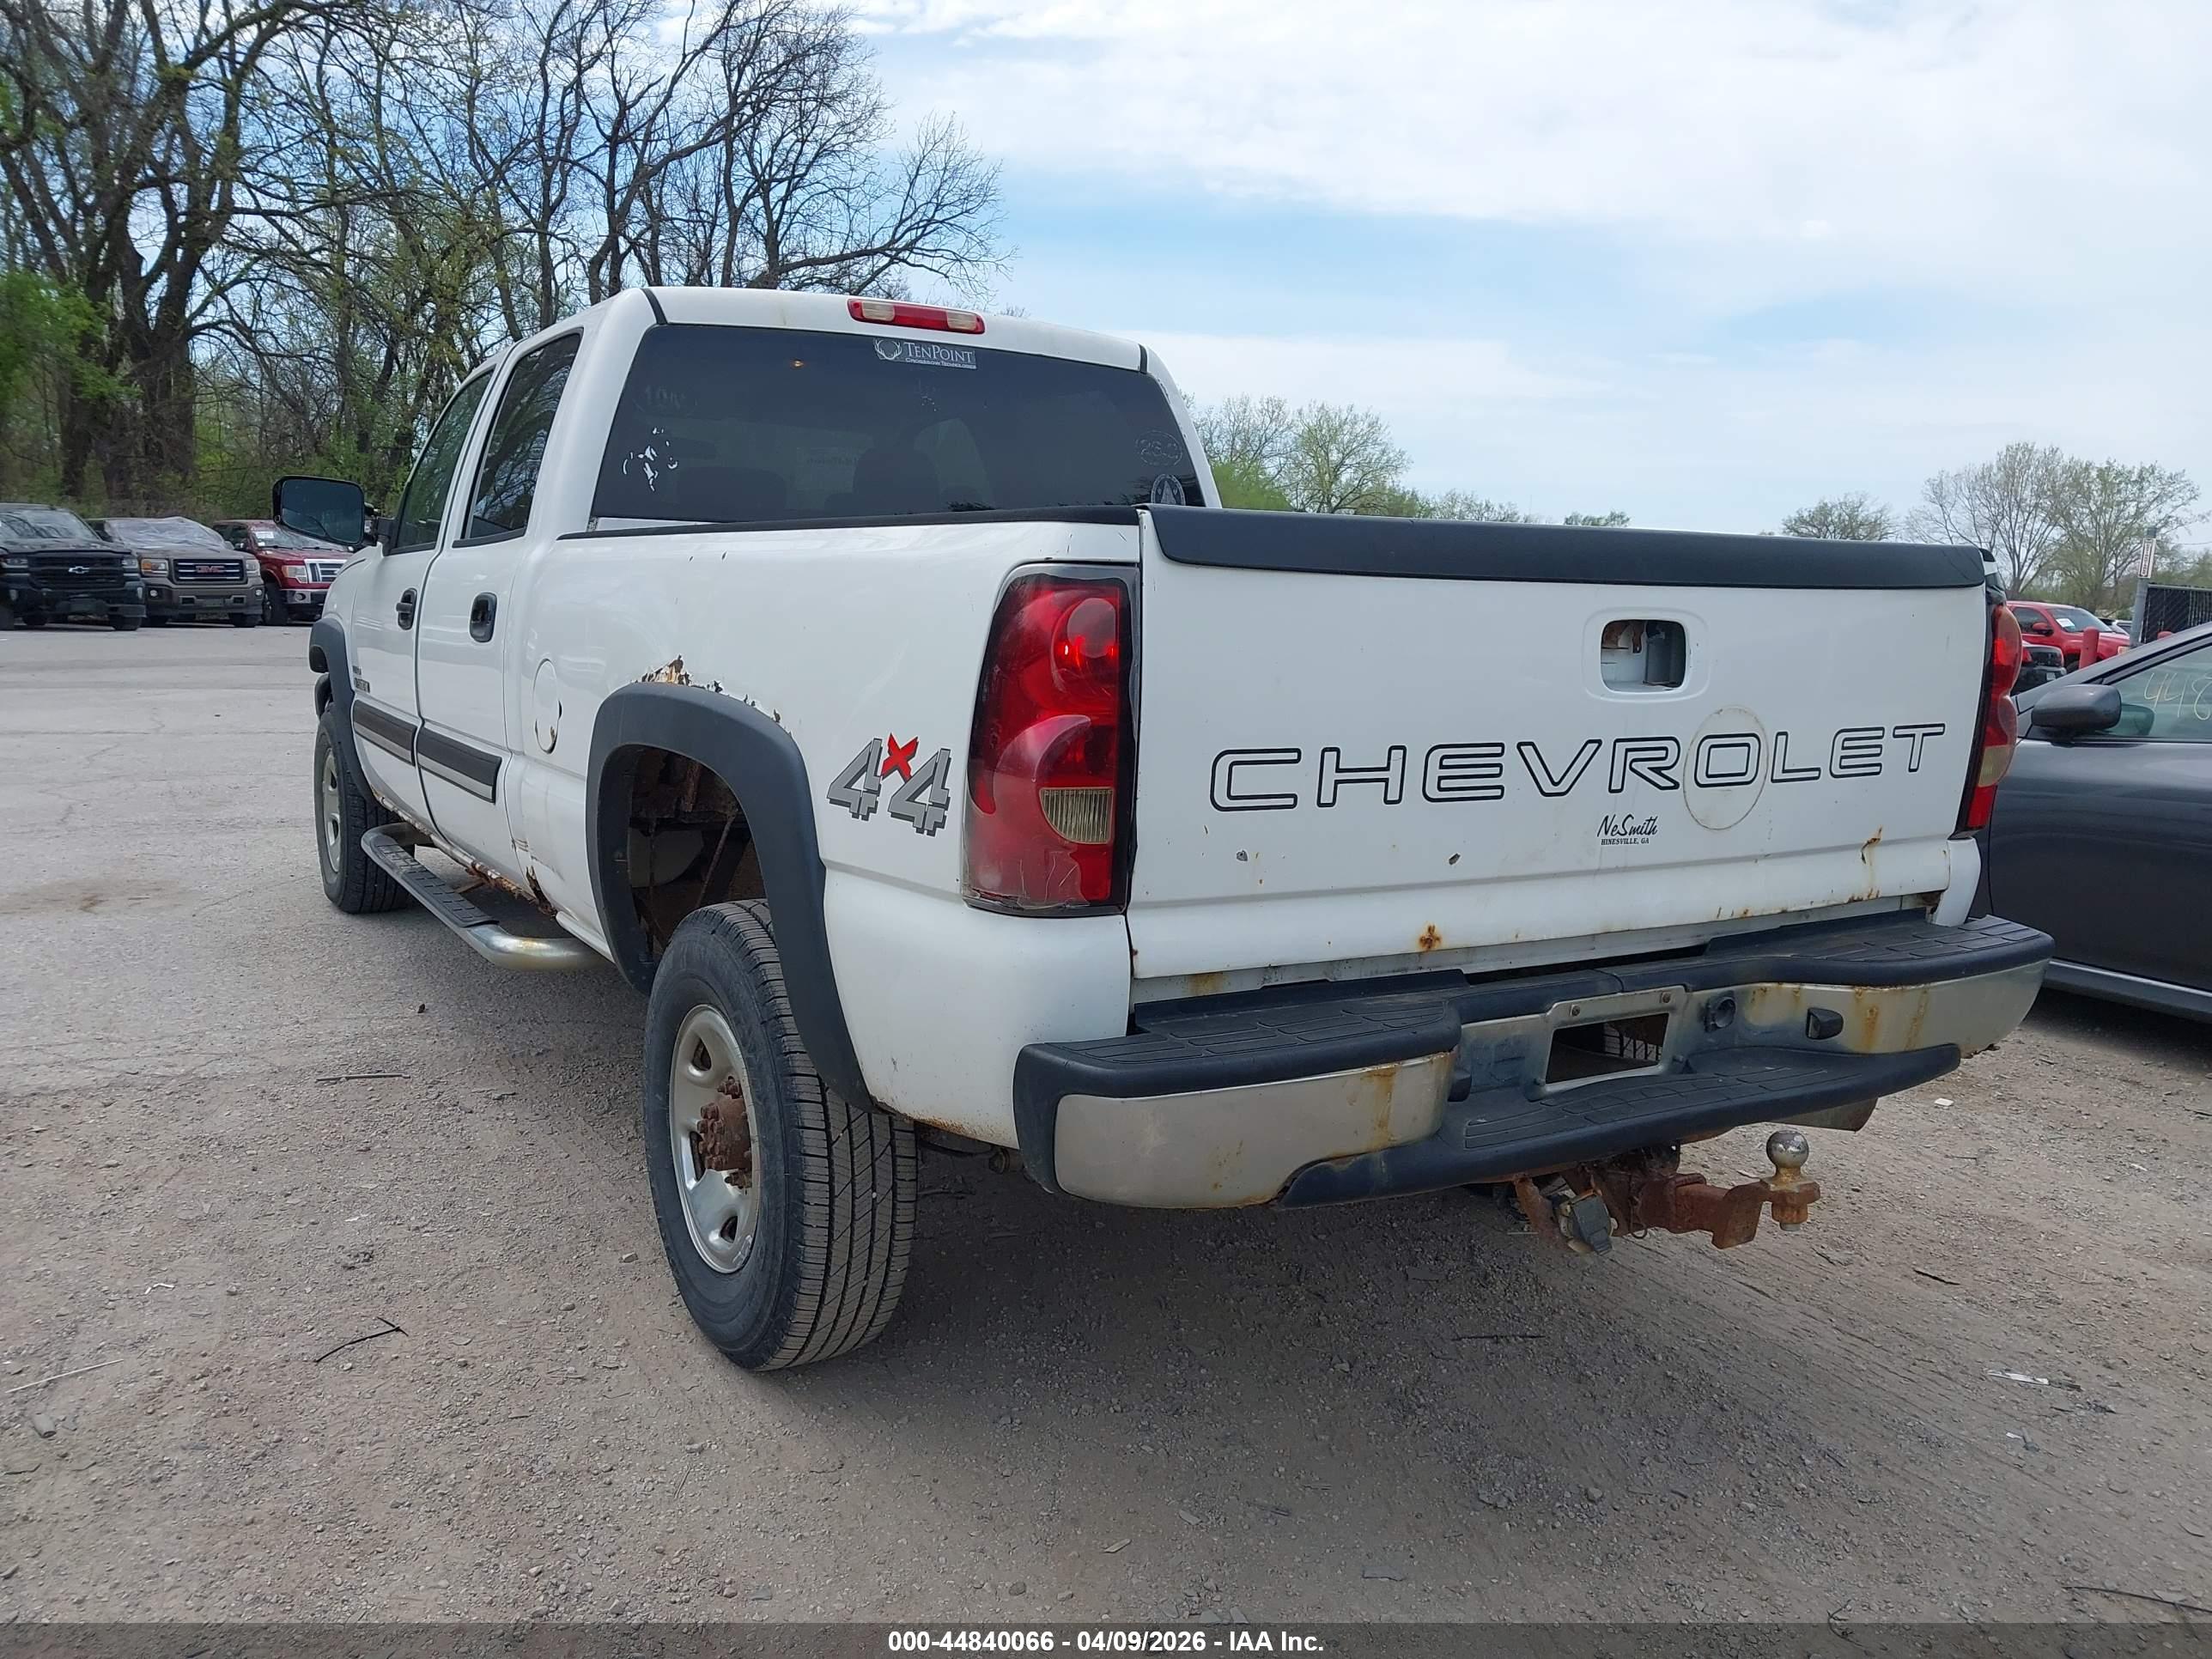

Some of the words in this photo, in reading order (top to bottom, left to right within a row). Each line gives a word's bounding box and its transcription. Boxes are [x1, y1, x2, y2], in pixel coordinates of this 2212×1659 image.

[195, 565, 225, 574] GMC
[1210, 723, 1945, 811] CHEVROLET
[1596, 813, 1659, 837] NeSmith
[1601, 837, 1639, 846] HINESVILLE,
